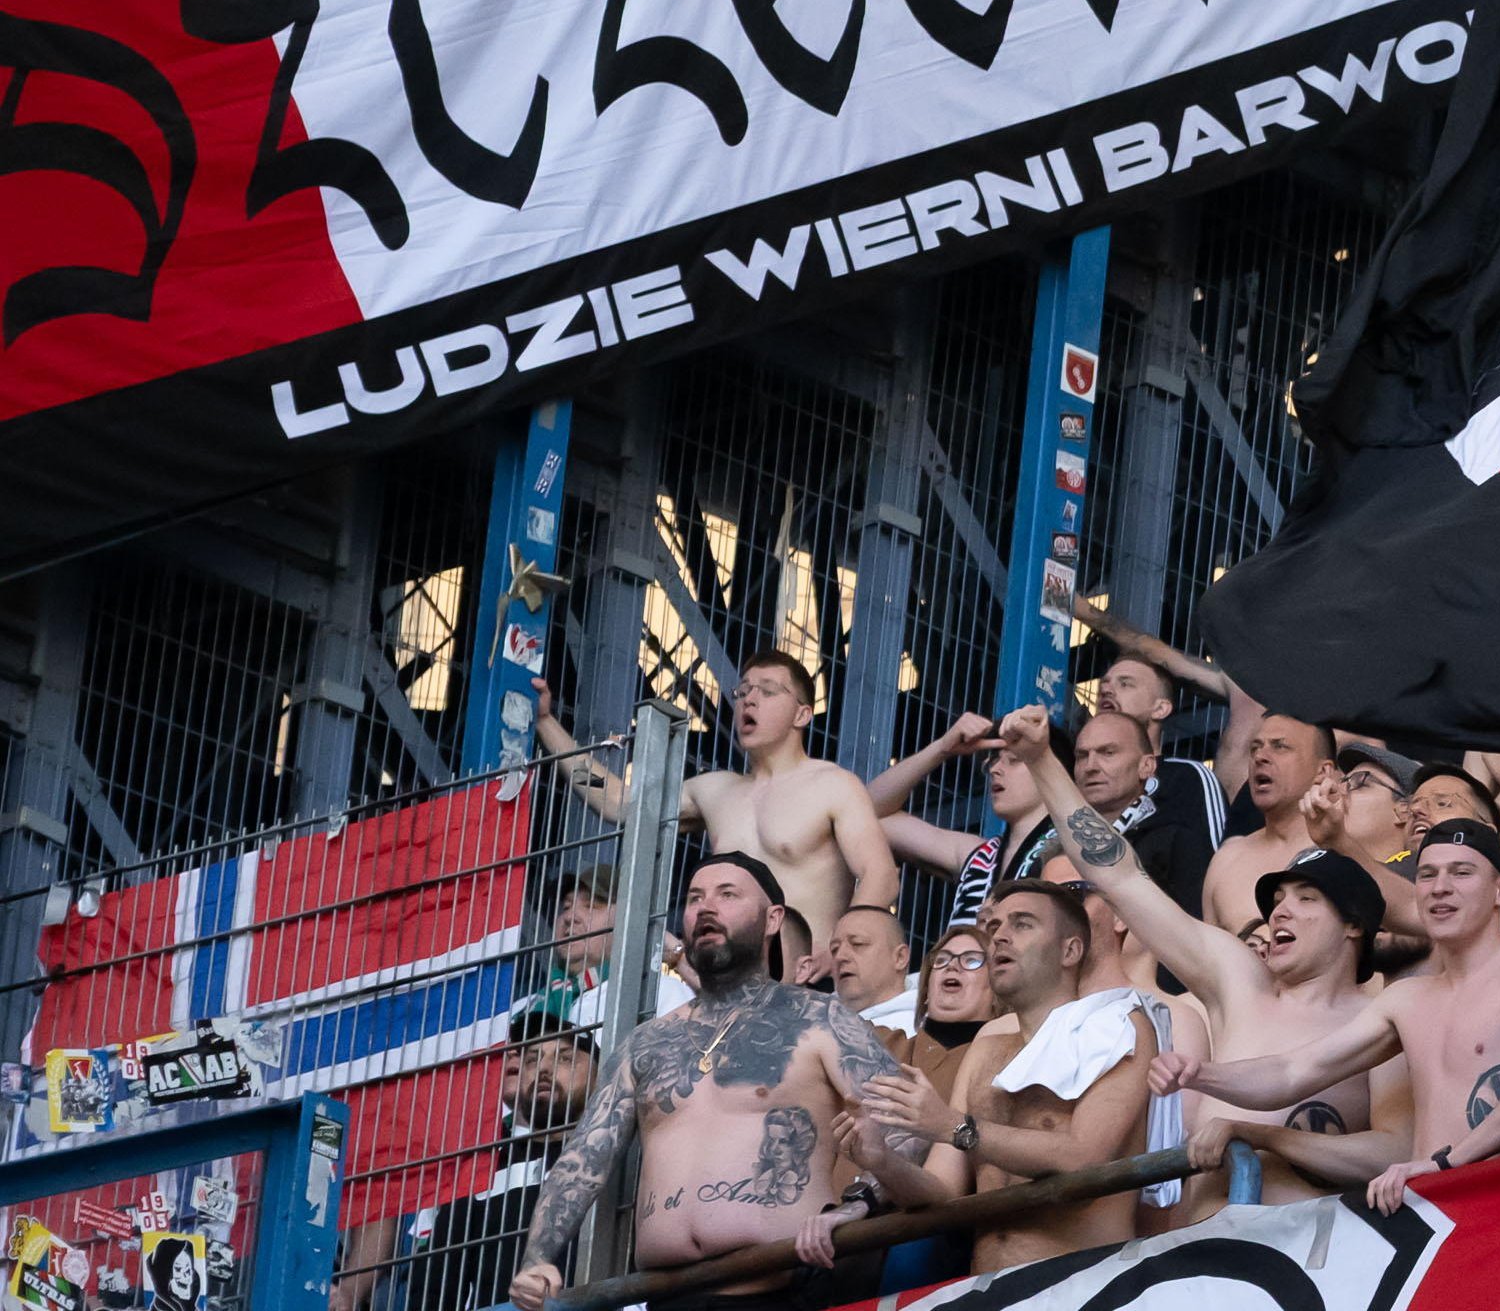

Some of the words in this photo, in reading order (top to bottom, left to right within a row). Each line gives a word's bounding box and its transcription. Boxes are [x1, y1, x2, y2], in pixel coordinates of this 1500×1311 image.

[271, 265, 694, 439] LUDZIE
[705, 147, 1084, 301] WIERNI
[1093, 9, 1475, 193] BARWO
[140, 1195, 164, 1210] 19
[23, 1270, 77, 1310] ULTRAS
